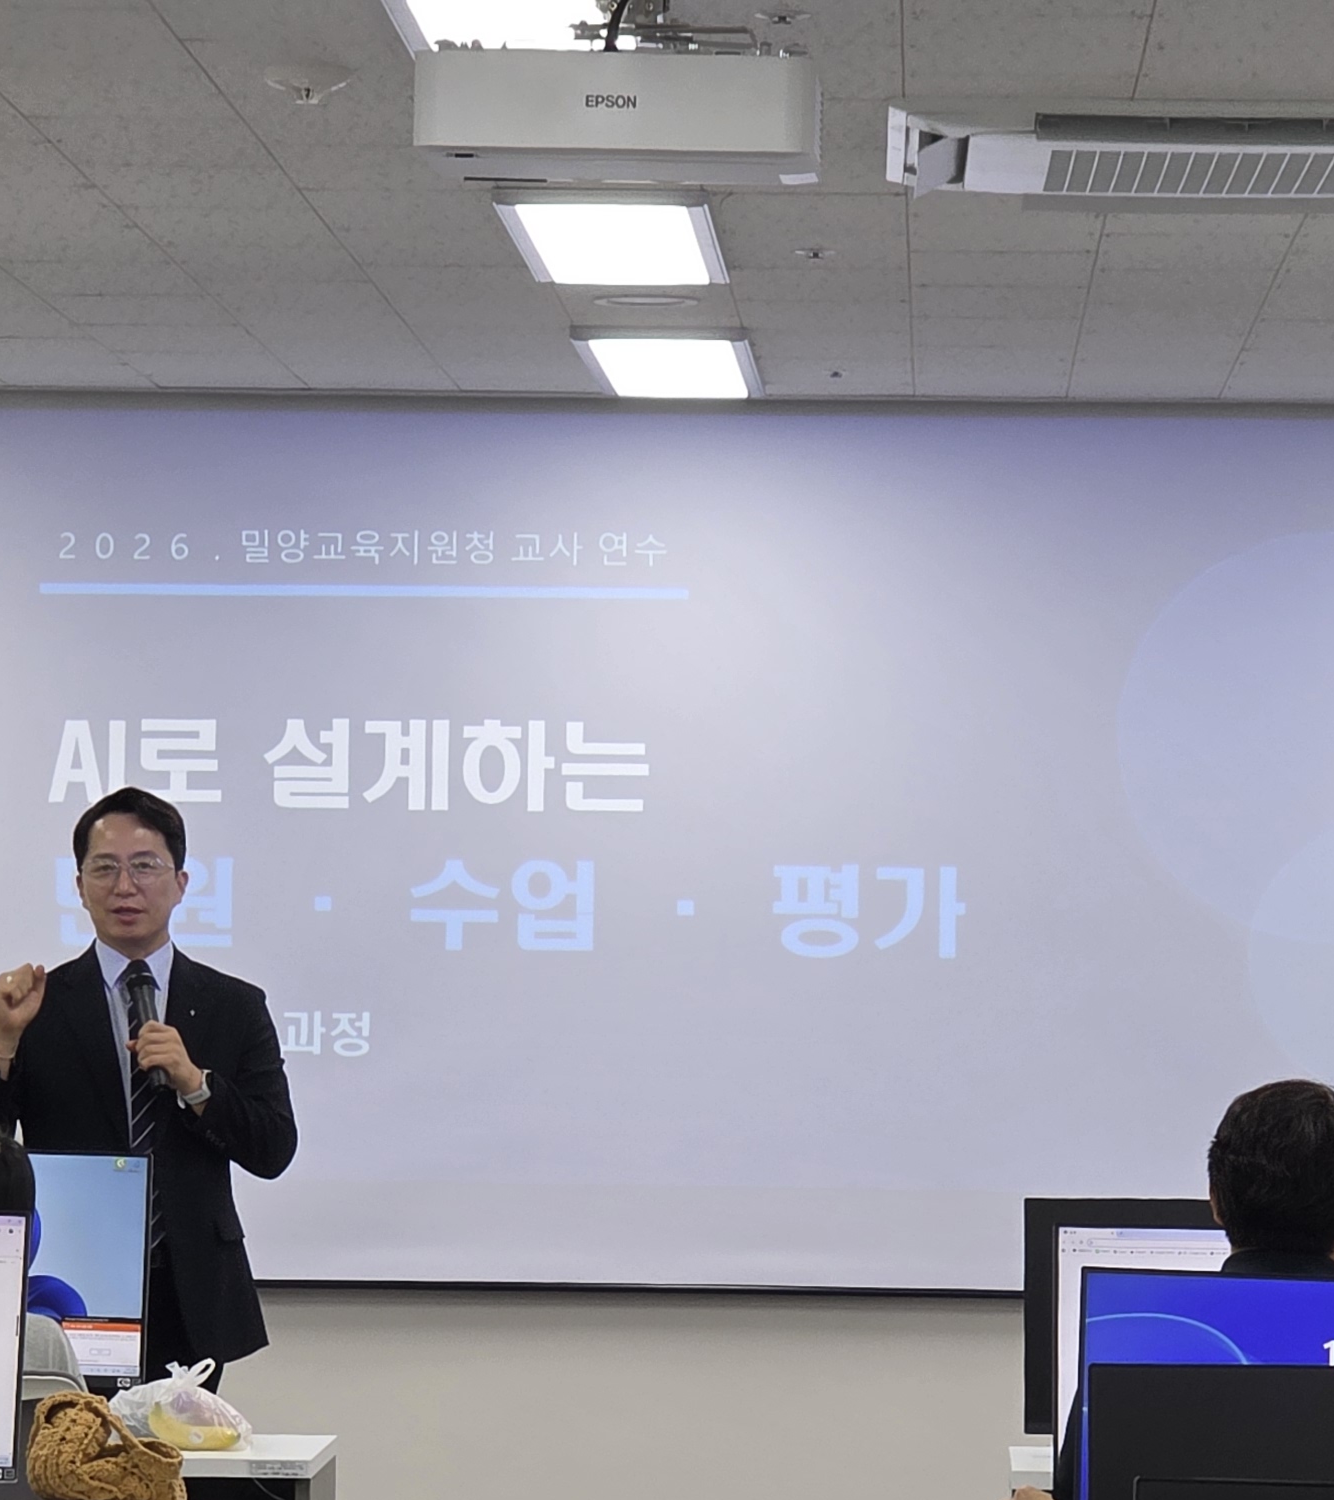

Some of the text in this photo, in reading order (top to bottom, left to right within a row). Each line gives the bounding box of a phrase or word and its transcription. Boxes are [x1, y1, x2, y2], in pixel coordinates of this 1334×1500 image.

[584, 94, 638, 109] EPSON
[240, 529, 497, 567] 밀양교육지원청
[510, 531, 584, 567] 교사
[597, 531, 668, 567] 연수
[48, 717, 651, 813] AI로 설계하는
[407, 858, 596, 953] 수업
[770, 863, 968, 960] 평가
